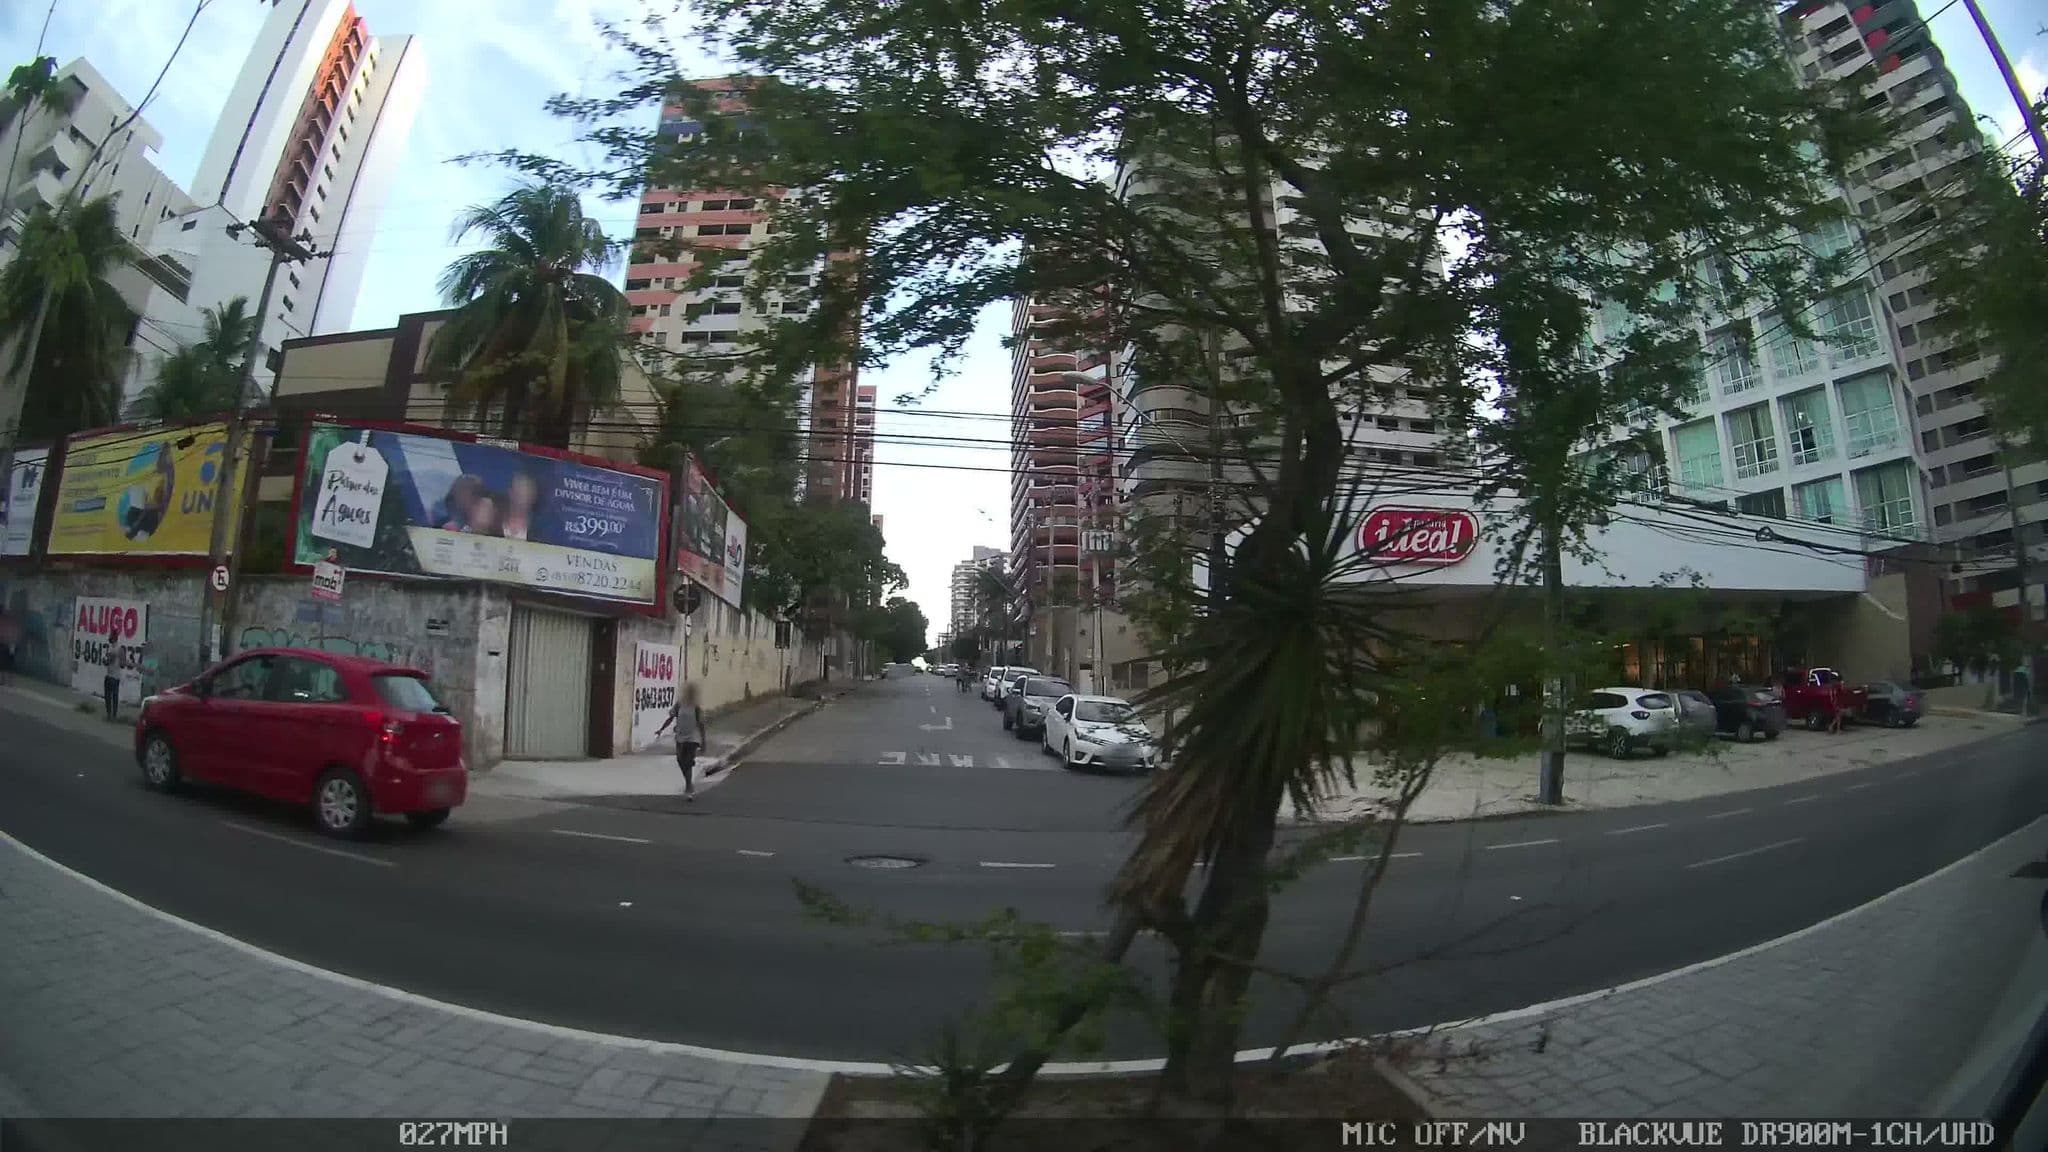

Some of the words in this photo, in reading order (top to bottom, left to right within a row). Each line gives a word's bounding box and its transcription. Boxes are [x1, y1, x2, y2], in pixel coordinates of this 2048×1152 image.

[567, 553, 618, 572] VENDAS
[77, 603, 138, 639] ALUGO
[638, 649, 673, 681] ALUGO
